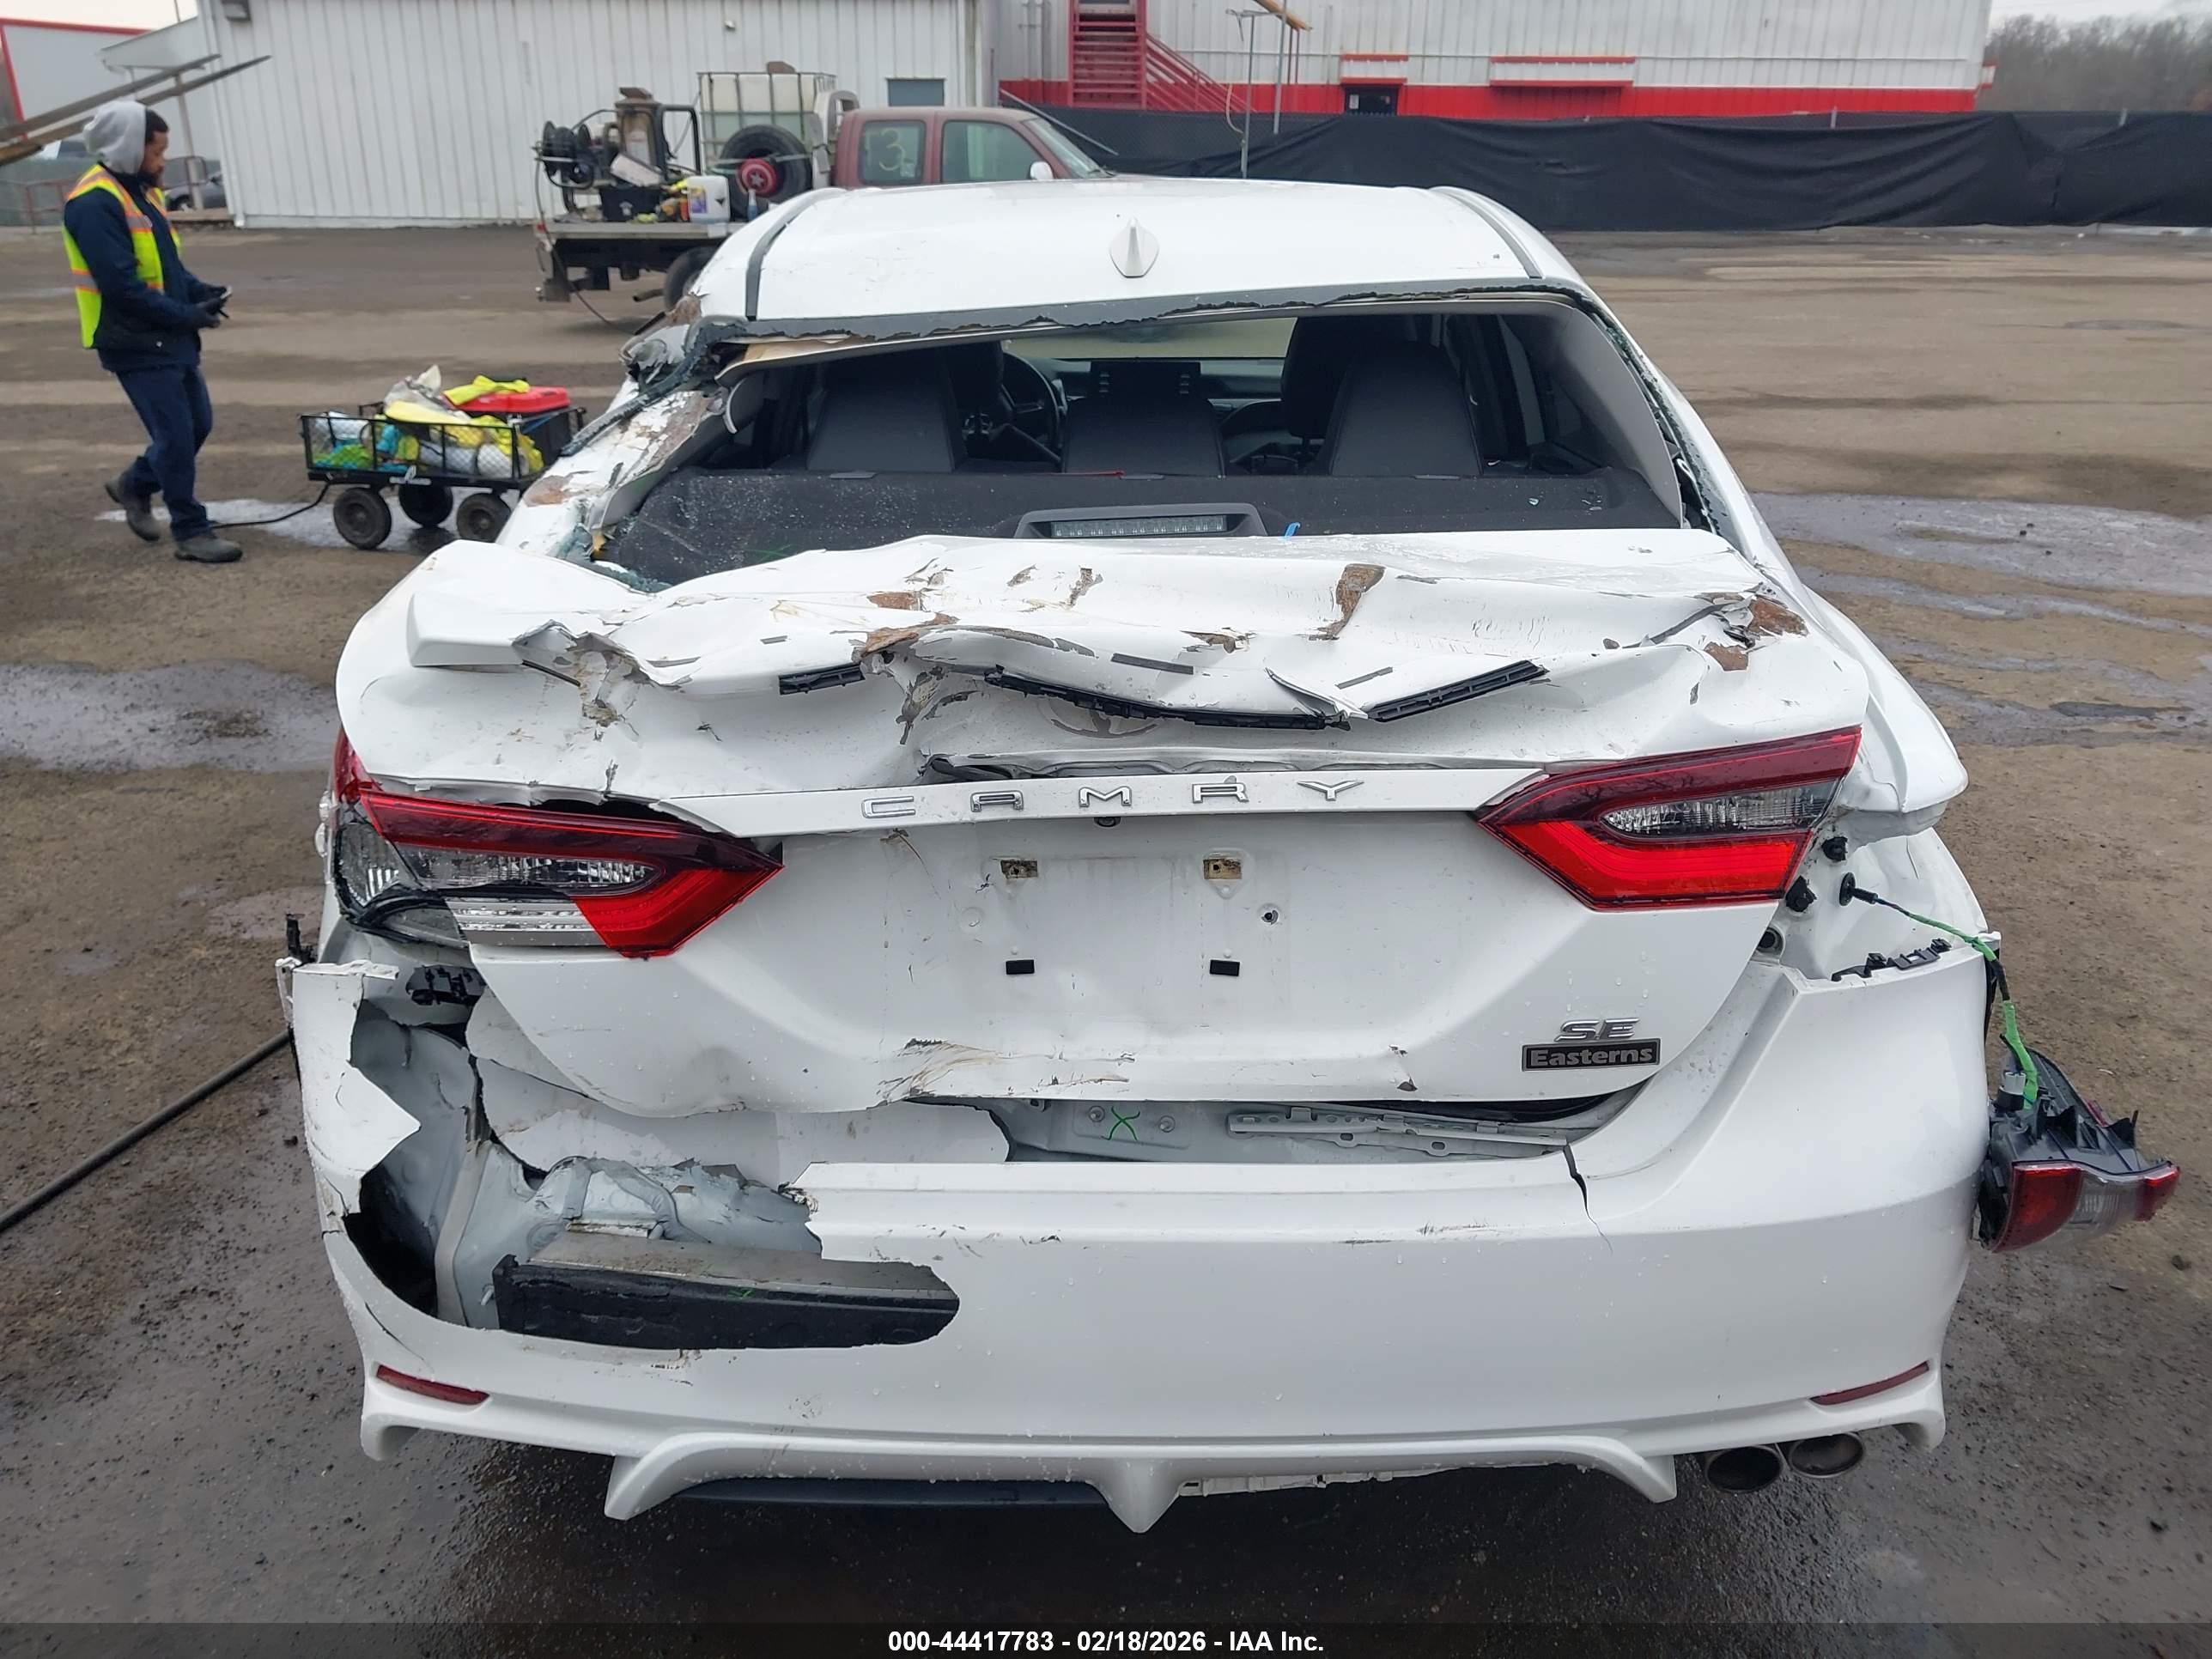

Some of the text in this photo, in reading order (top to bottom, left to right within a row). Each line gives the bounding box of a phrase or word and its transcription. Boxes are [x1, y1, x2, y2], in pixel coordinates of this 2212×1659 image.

[860, 780, 1365, 819] CAMRY
[1553, 1018, 1640, 1042] SE
[1530, 1048, 1653, 1066] Easterns
